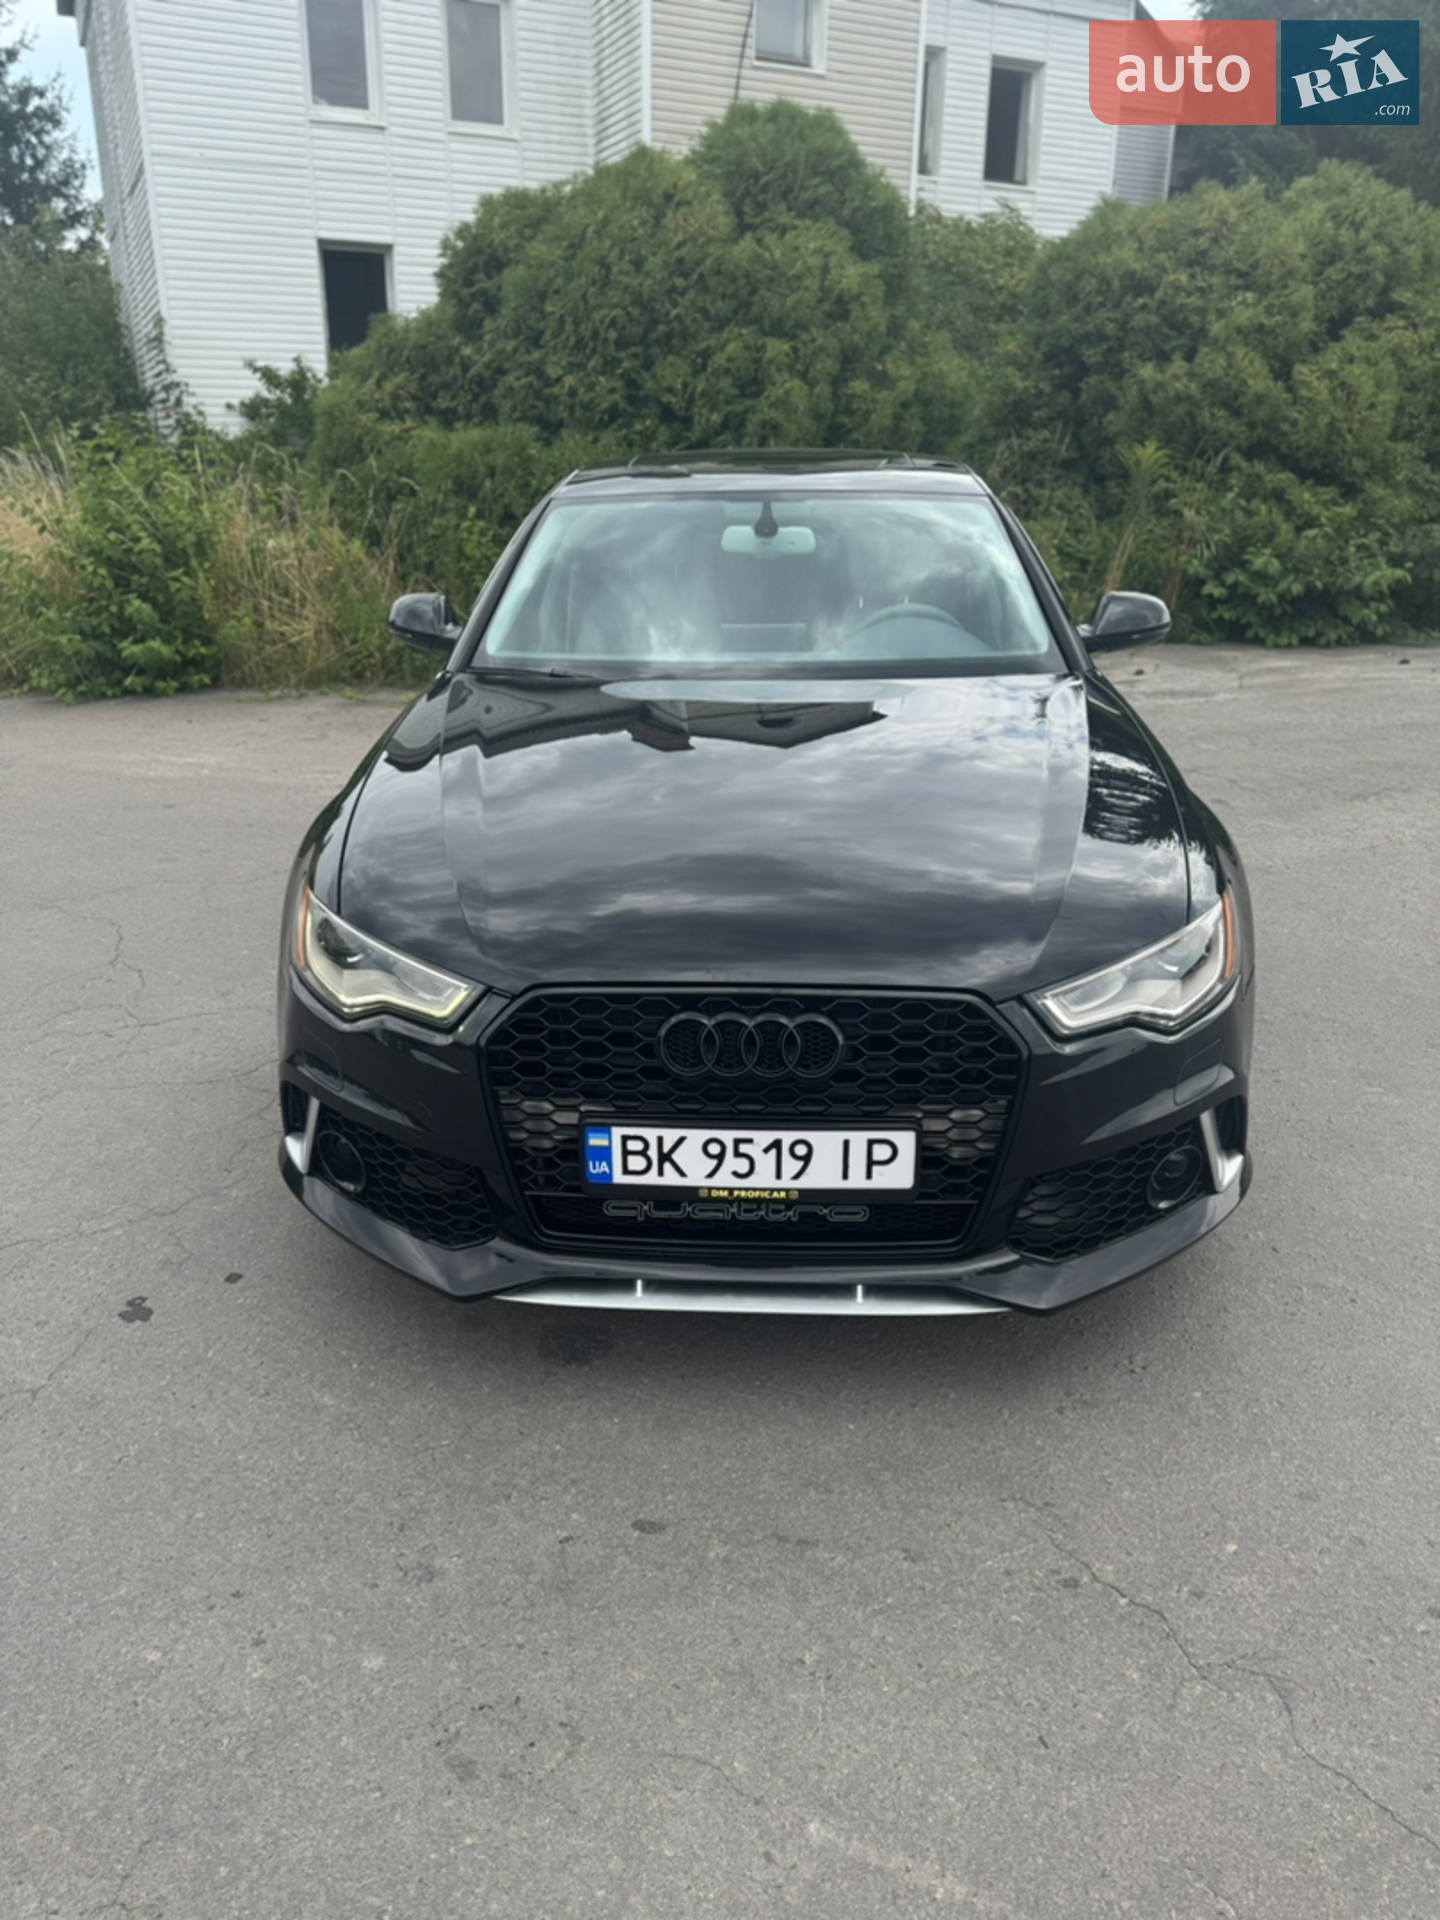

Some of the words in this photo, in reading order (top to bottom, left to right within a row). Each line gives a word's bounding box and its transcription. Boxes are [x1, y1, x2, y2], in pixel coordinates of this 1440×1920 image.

[589, 1161, 609, 1174] UA
[621, 1134, 688, 1178] BK
[701, 1137, 814, 1181] 9519
[842, 1138, 899, 1181] IP
[603, 1201, 869, 1221] quattro
